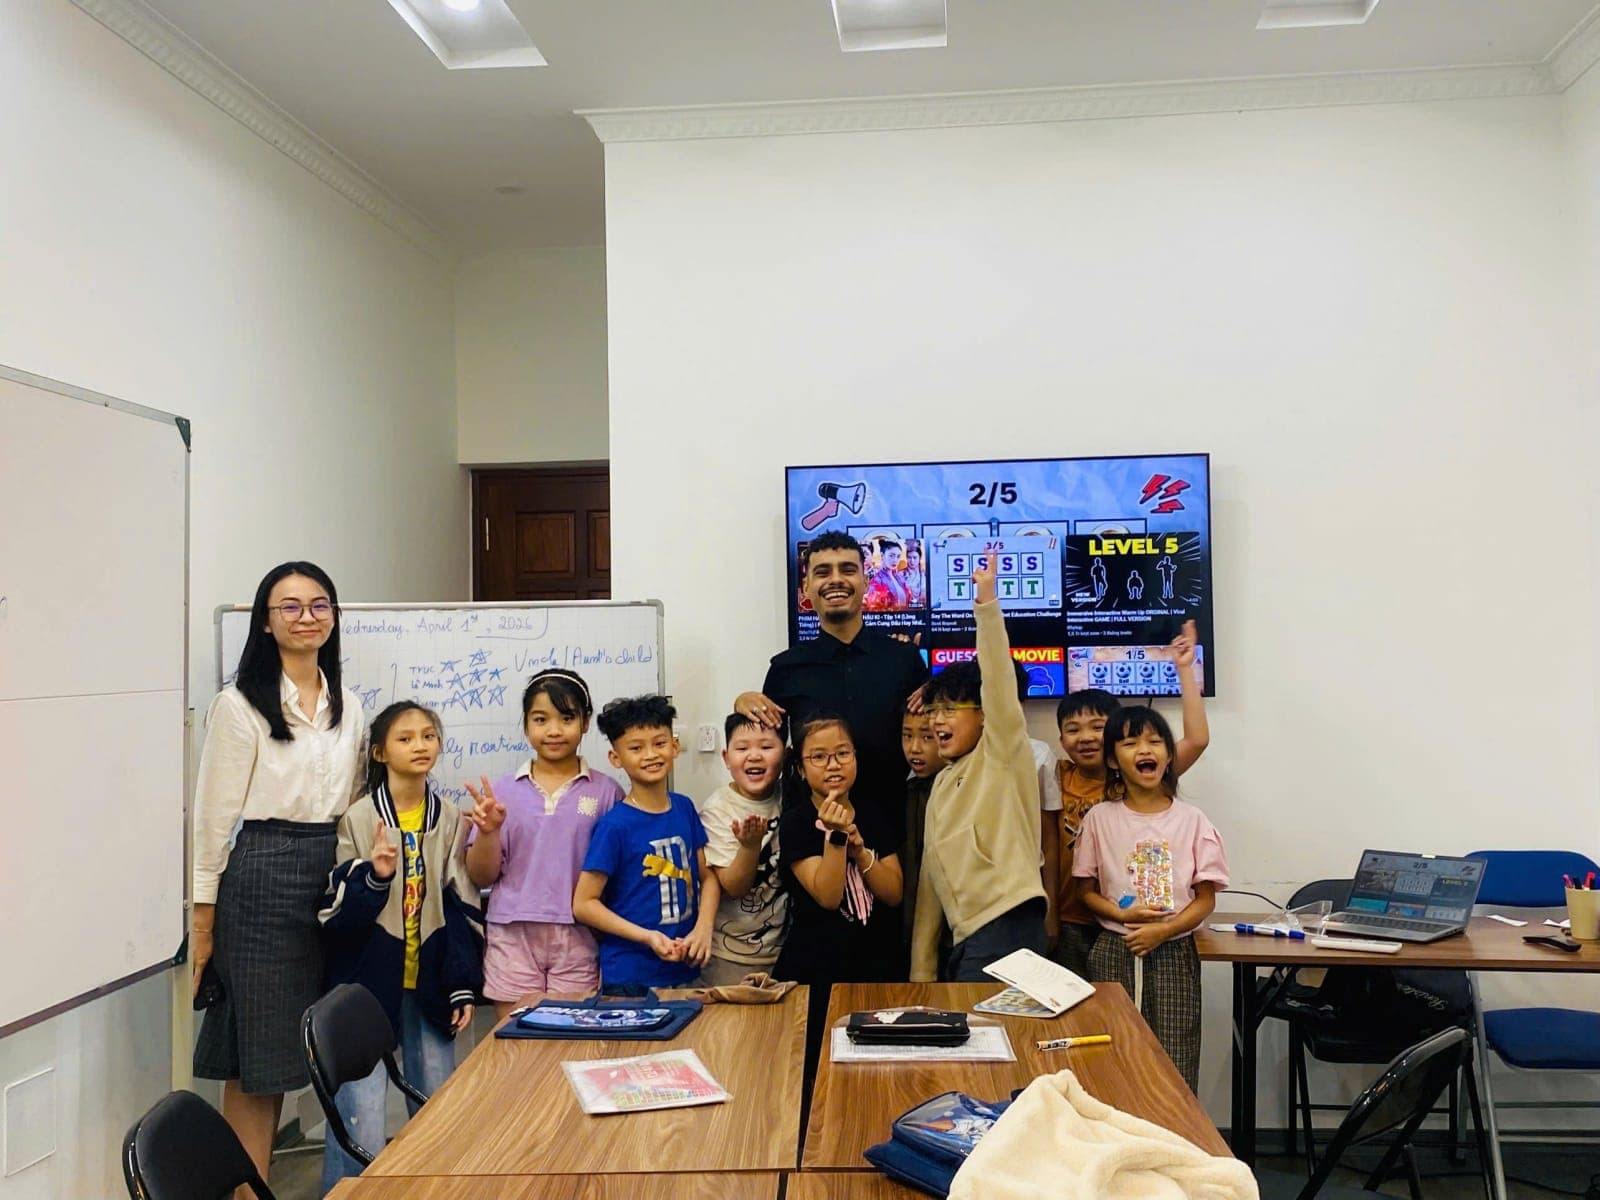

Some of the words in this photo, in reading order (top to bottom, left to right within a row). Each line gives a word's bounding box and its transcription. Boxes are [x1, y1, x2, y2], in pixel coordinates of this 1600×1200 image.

[968, 482, 1018, 506] 2/5
[1089, 538, 1158, 556] LEVEL
[1164, 537, 1179, 554] 5
[953, 558, 964, 573] S
[977, 557, 988, 571] S
[1002, 556, 1013, 571] S
[1026, 556, 1038, 571] S
[953, 582, 966, 597] T
[1002, 580, 1014, 596] T
[1027, 580, 1039, 595] T
[417, 616, 453, 634] April
[498, 615, 533, 630] 2026
[1013, 649, 1060, 662] MOVIE
[1126, 649, 1145, 660] 1/5
